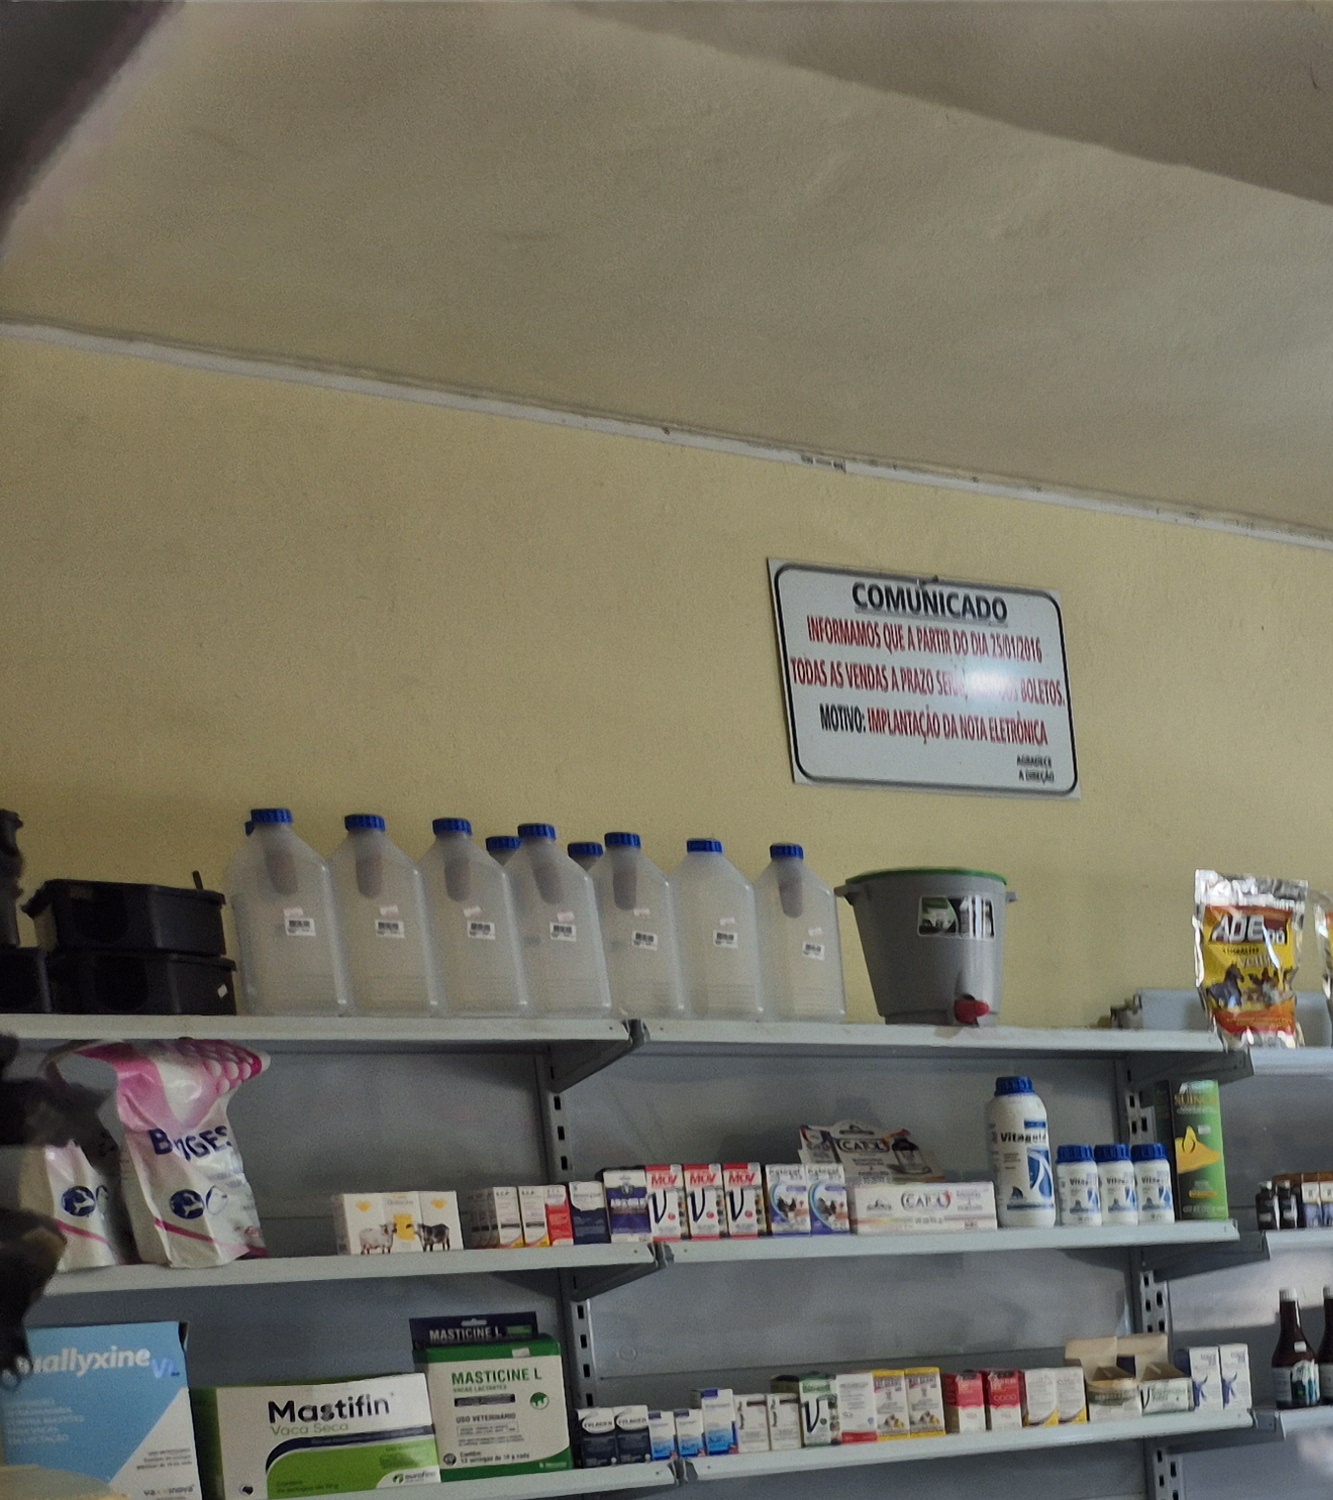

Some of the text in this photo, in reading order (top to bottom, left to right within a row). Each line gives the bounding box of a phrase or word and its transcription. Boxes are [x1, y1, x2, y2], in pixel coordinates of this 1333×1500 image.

[852, 581, 1008, 624] COMUNICADO
[807, 615, 881, 650] INFORMAMOS
[883, 623, 905, 654] QUE
[908, 625, 916, 651] A
[917, 625, 951, 656] PARTIR
[954, 629, 968, 656] DO
[970, 630, 989, 658] DIA
[790, 657, 827, 687] TODAS
[830, 660, 844, 689] AS
[845, 661, 889, 693] VENDAS
[891, 666, 900, 692] A
[902, 666, 934, 696] PRAZO
[820, 703, 1048, 746] MOTIVO: IMPLANTAÇÃO DA NOTA ELETRÔNICA
[1212, 913, 1265, 943] ADE
[429, 1326, 503, 1342] MASTICINE L
[451, 1368, 542, 1386] MASTICINE L
[268, 1393, 391, 1424] Mastifin
[456, 1415, 471, 1424] USO
[271, 1422, 349, 1436] Vaca Seca
